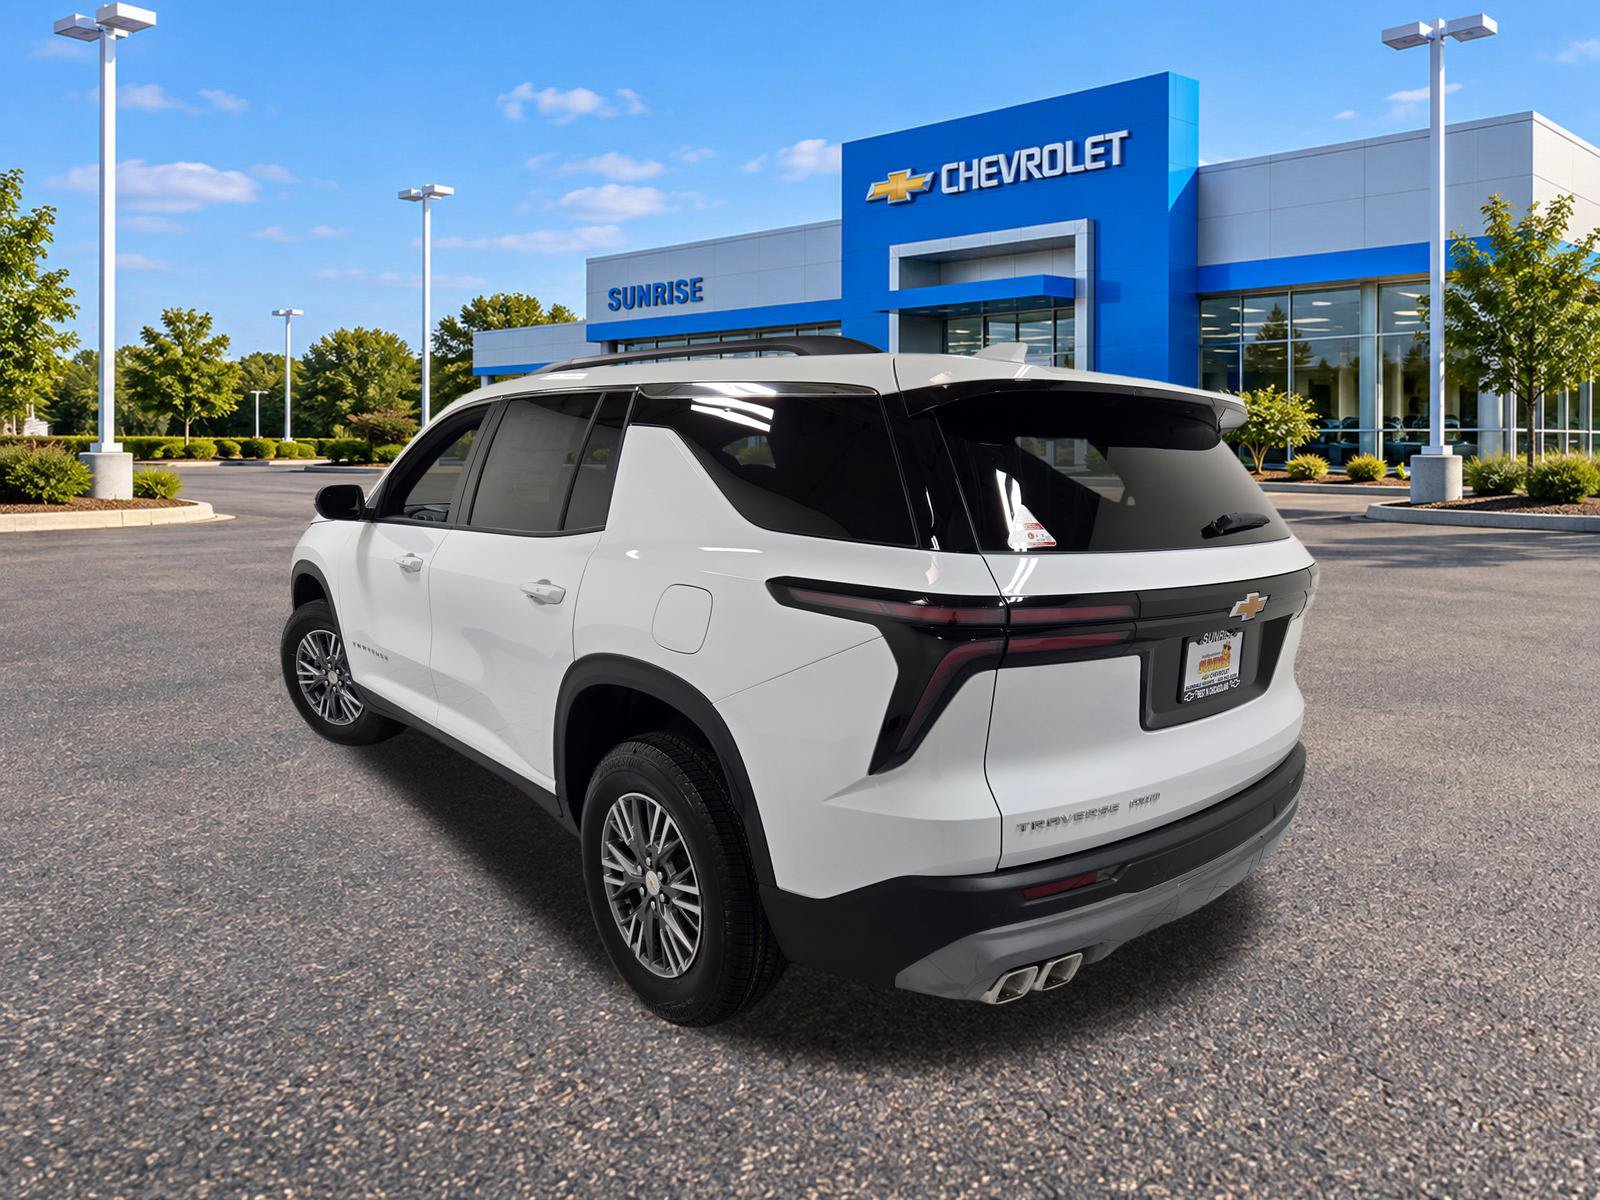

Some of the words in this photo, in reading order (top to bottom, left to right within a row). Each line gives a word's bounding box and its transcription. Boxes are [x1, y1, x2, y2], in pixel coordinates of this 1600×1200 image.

[941, 130, 1129, 194] CHEVROLET
[608, 277, 704, 312] SUNRISE
[1203, 630, 1233, 644] SUNRIS
[1016, 802, 1120, 832] TRAVERSE
